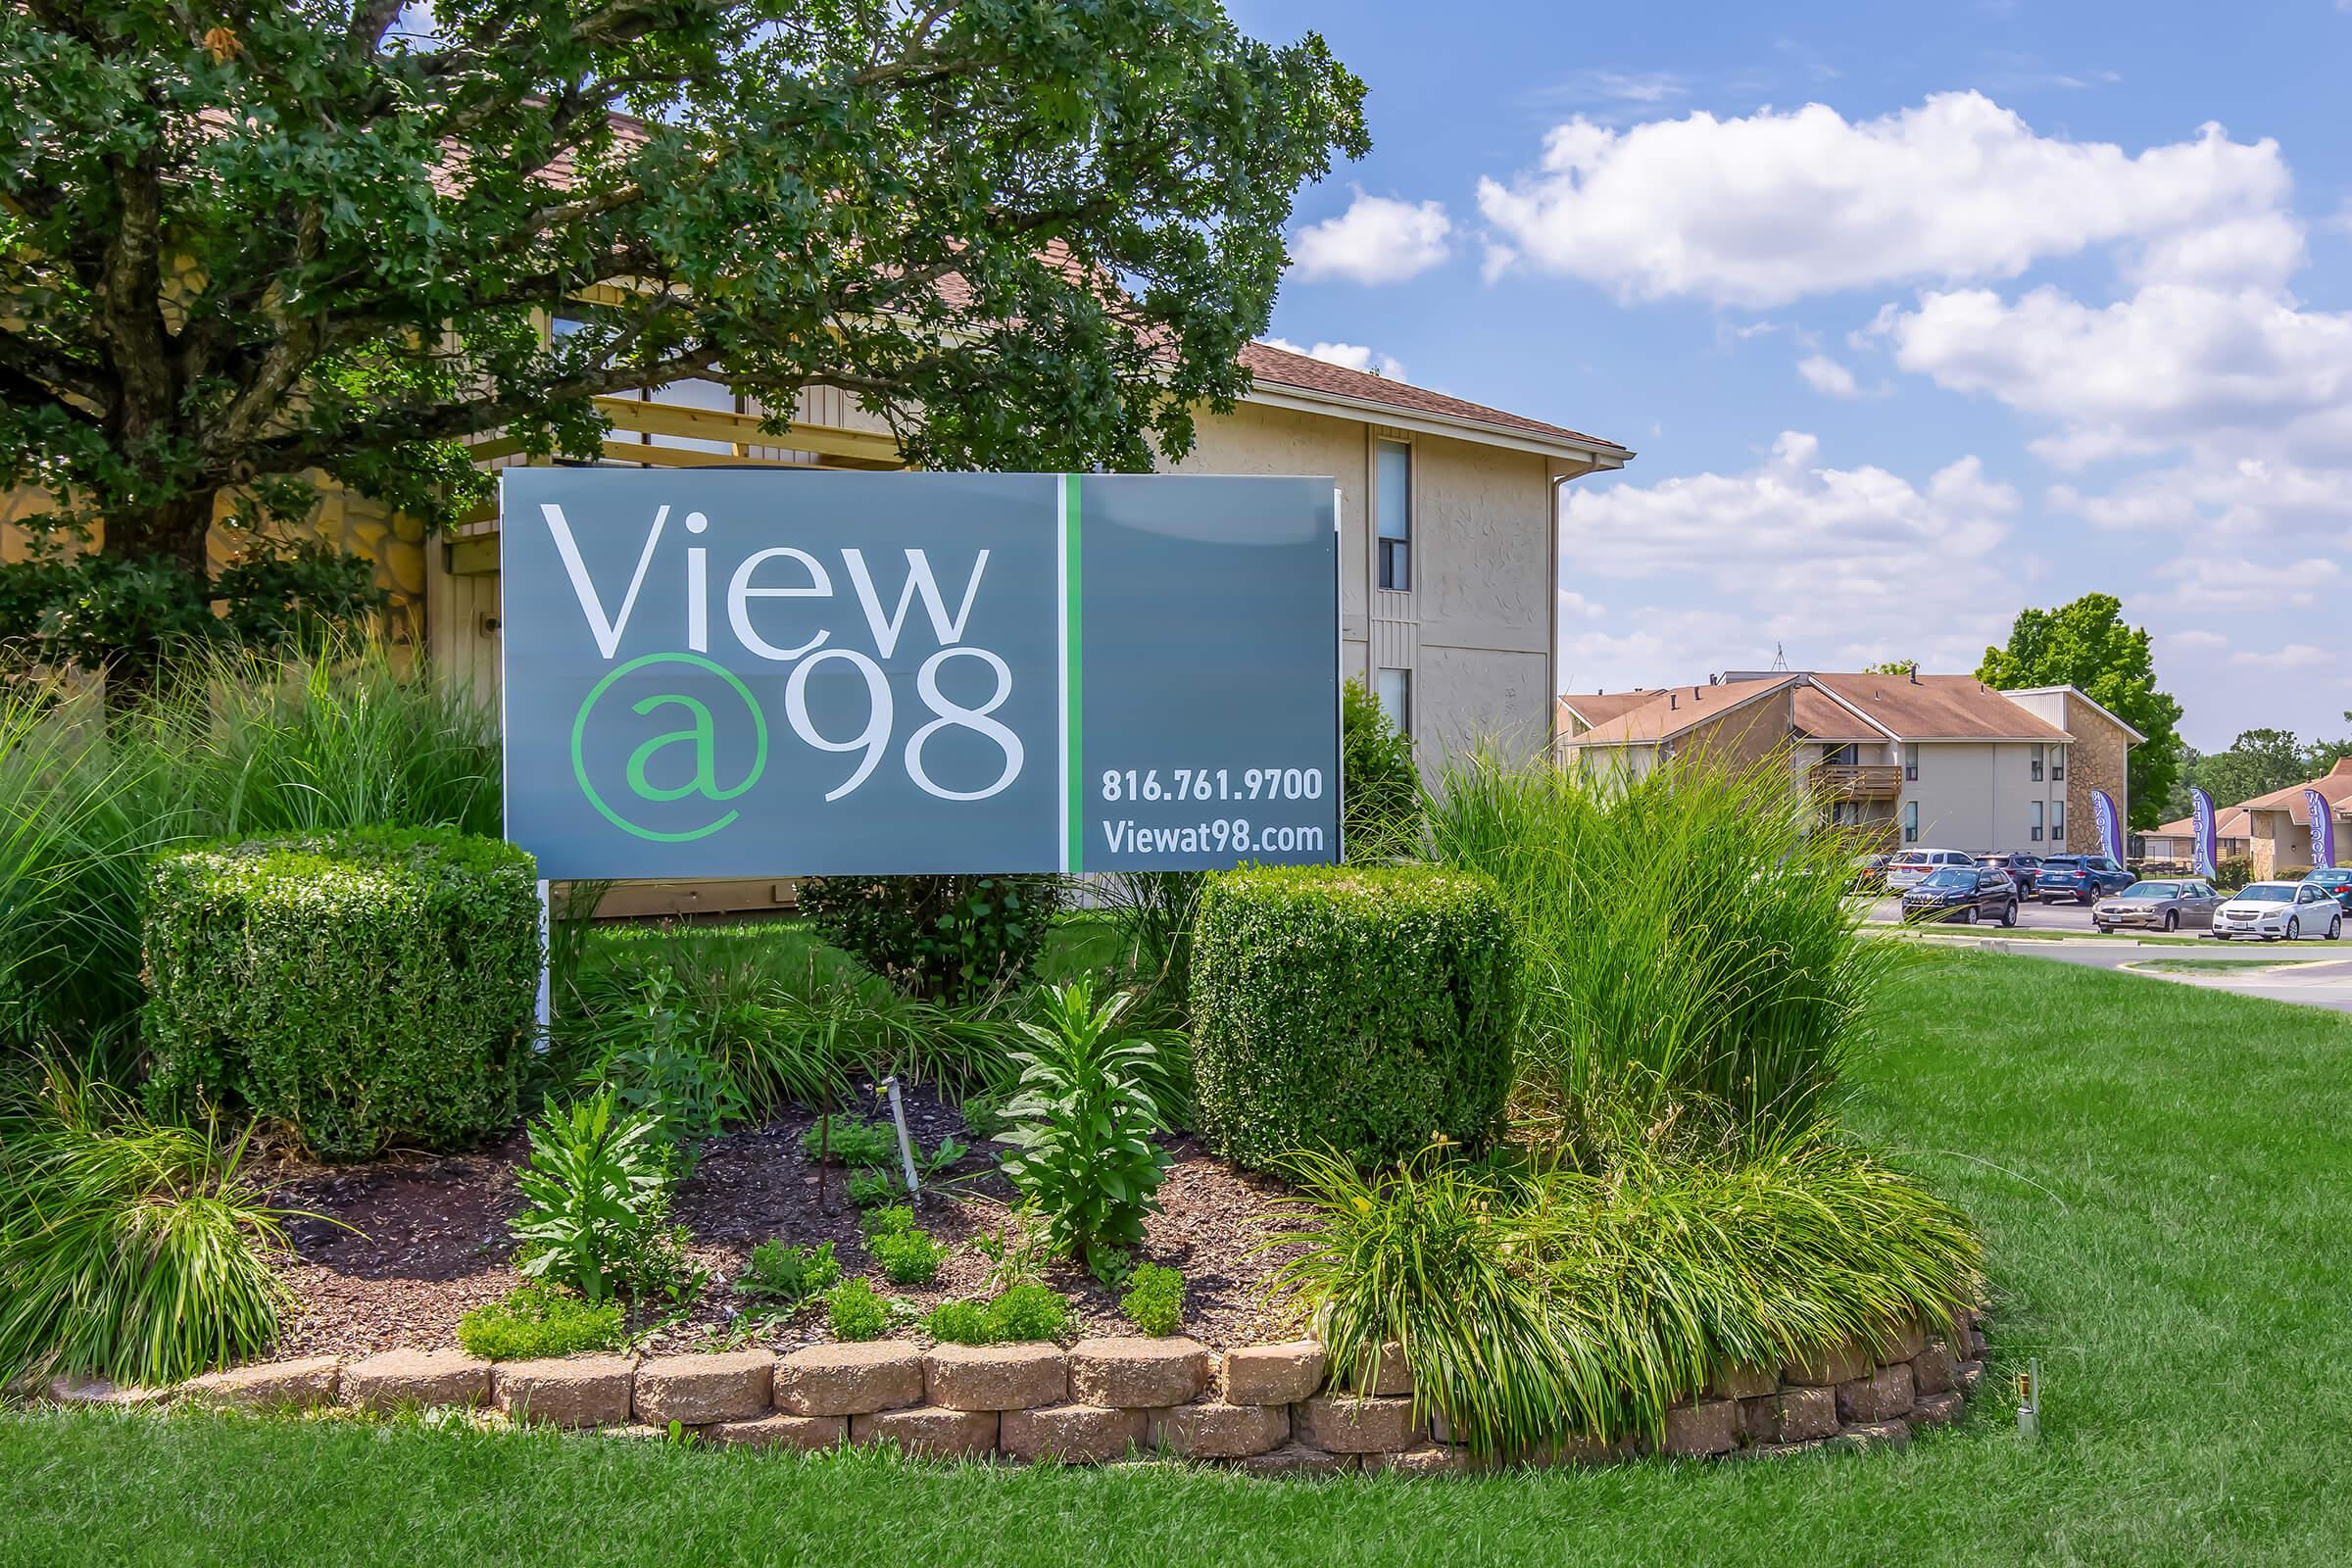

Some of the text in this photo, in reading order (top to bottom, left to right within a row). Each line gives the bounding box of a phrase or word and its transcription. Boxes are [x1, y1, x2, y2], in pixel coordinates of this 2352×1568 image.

[540, 503, 990, 661] View
[1102, 768, 1323, 802] 816.761.9700
[1102, 818, 1323, 853] Viewat98.com
